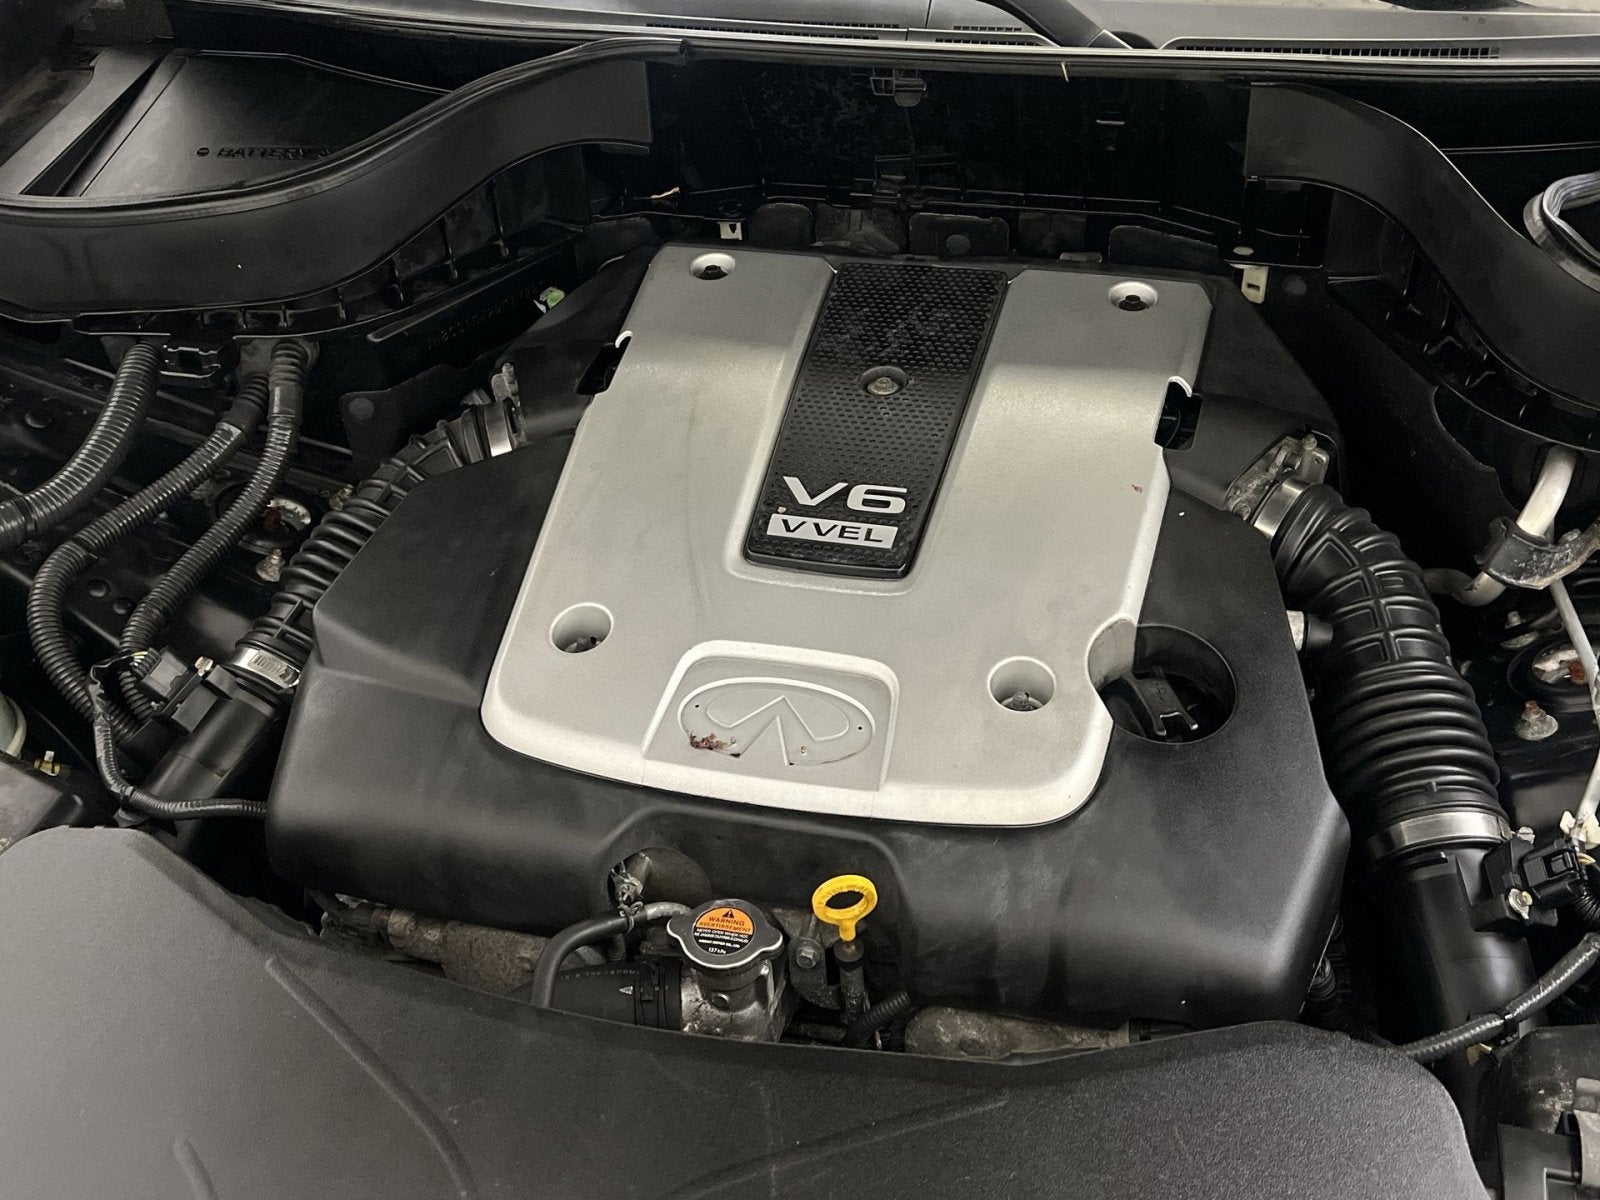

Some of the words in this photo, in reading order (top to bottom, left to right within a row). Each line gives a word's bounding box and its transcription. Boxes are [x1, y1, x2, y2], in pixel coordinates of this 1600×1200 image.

[782, 476, 908, 514] V6
[781, 518, 884, 543] VVEL
[699, 922, 751, 933] AVERTISSEMENT
[708, 916, 745, 926] WARNING
